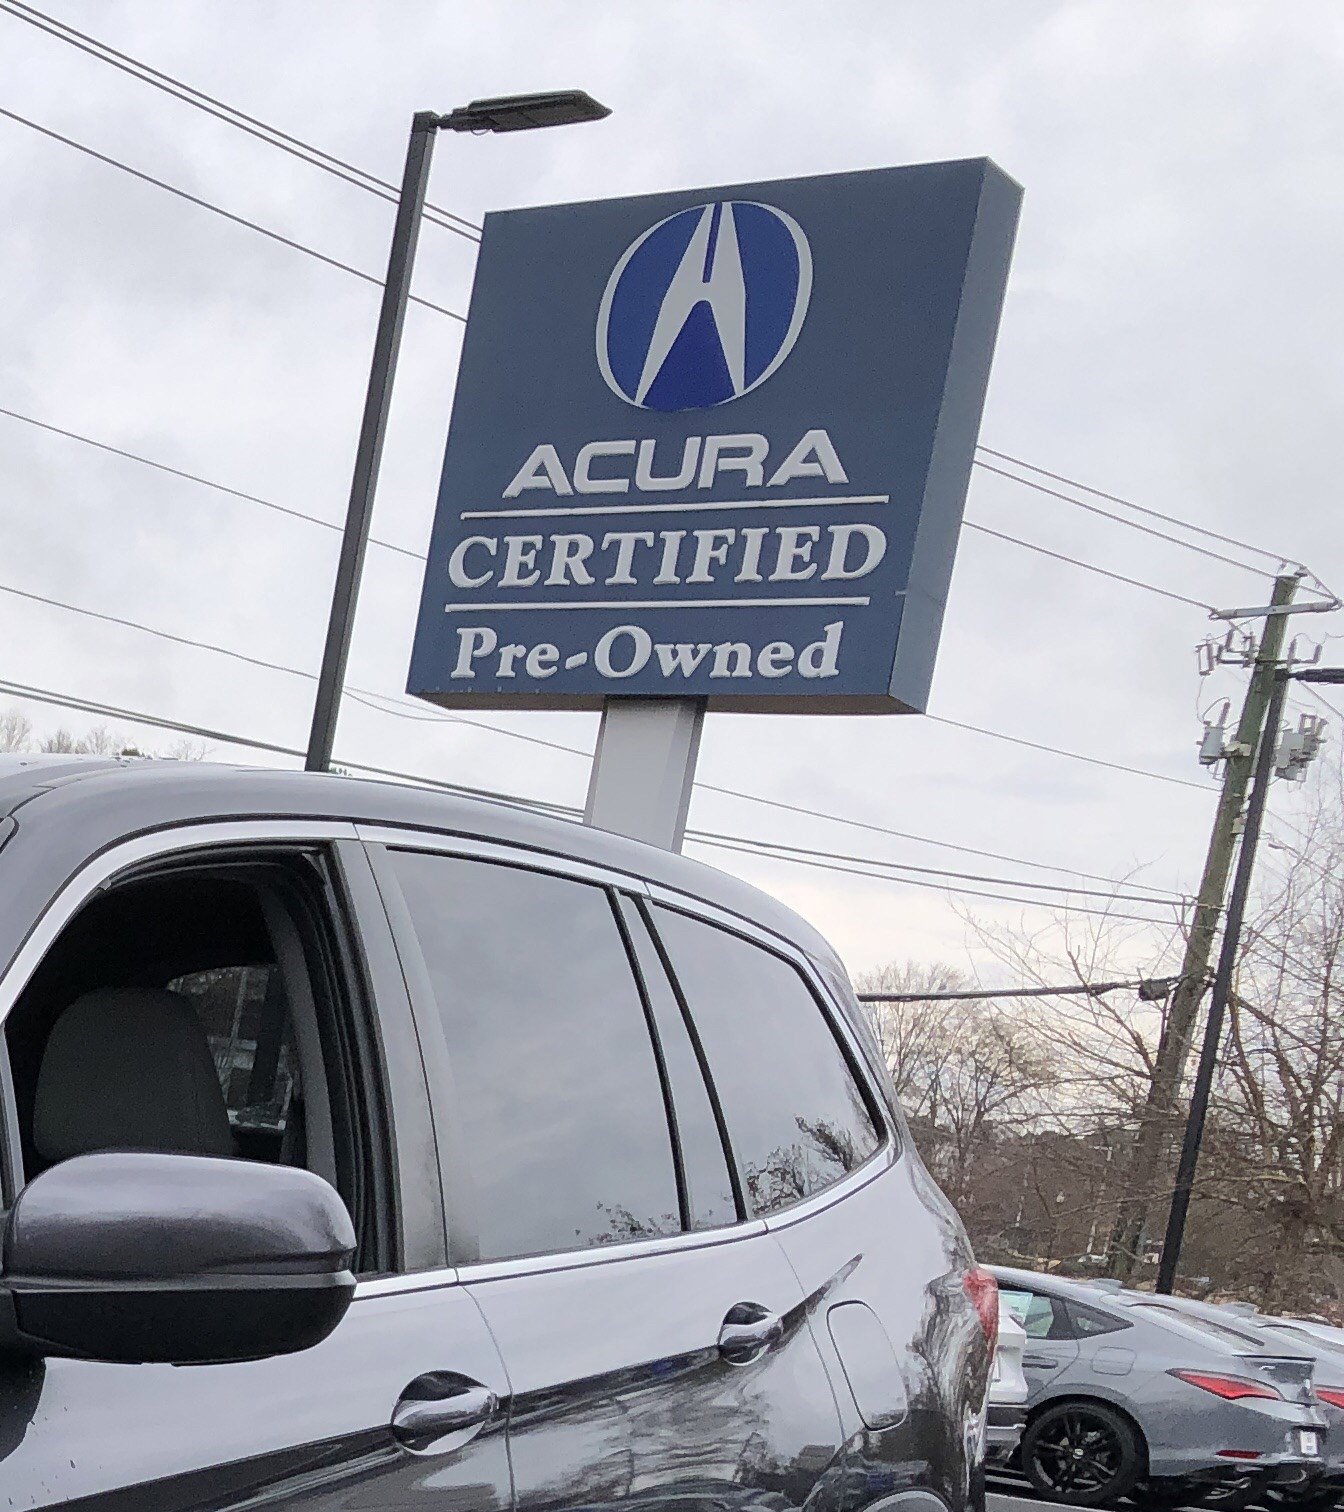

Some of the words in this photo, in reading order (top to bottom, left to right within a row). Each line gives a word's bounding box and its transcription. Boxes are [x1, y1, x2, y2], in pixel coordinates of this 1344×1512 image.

[502, 429, 849, 498] ACURA
[447, 523, 887, 588] CERTIFIED
[450, 620, 844, 679] Pre-Owned
